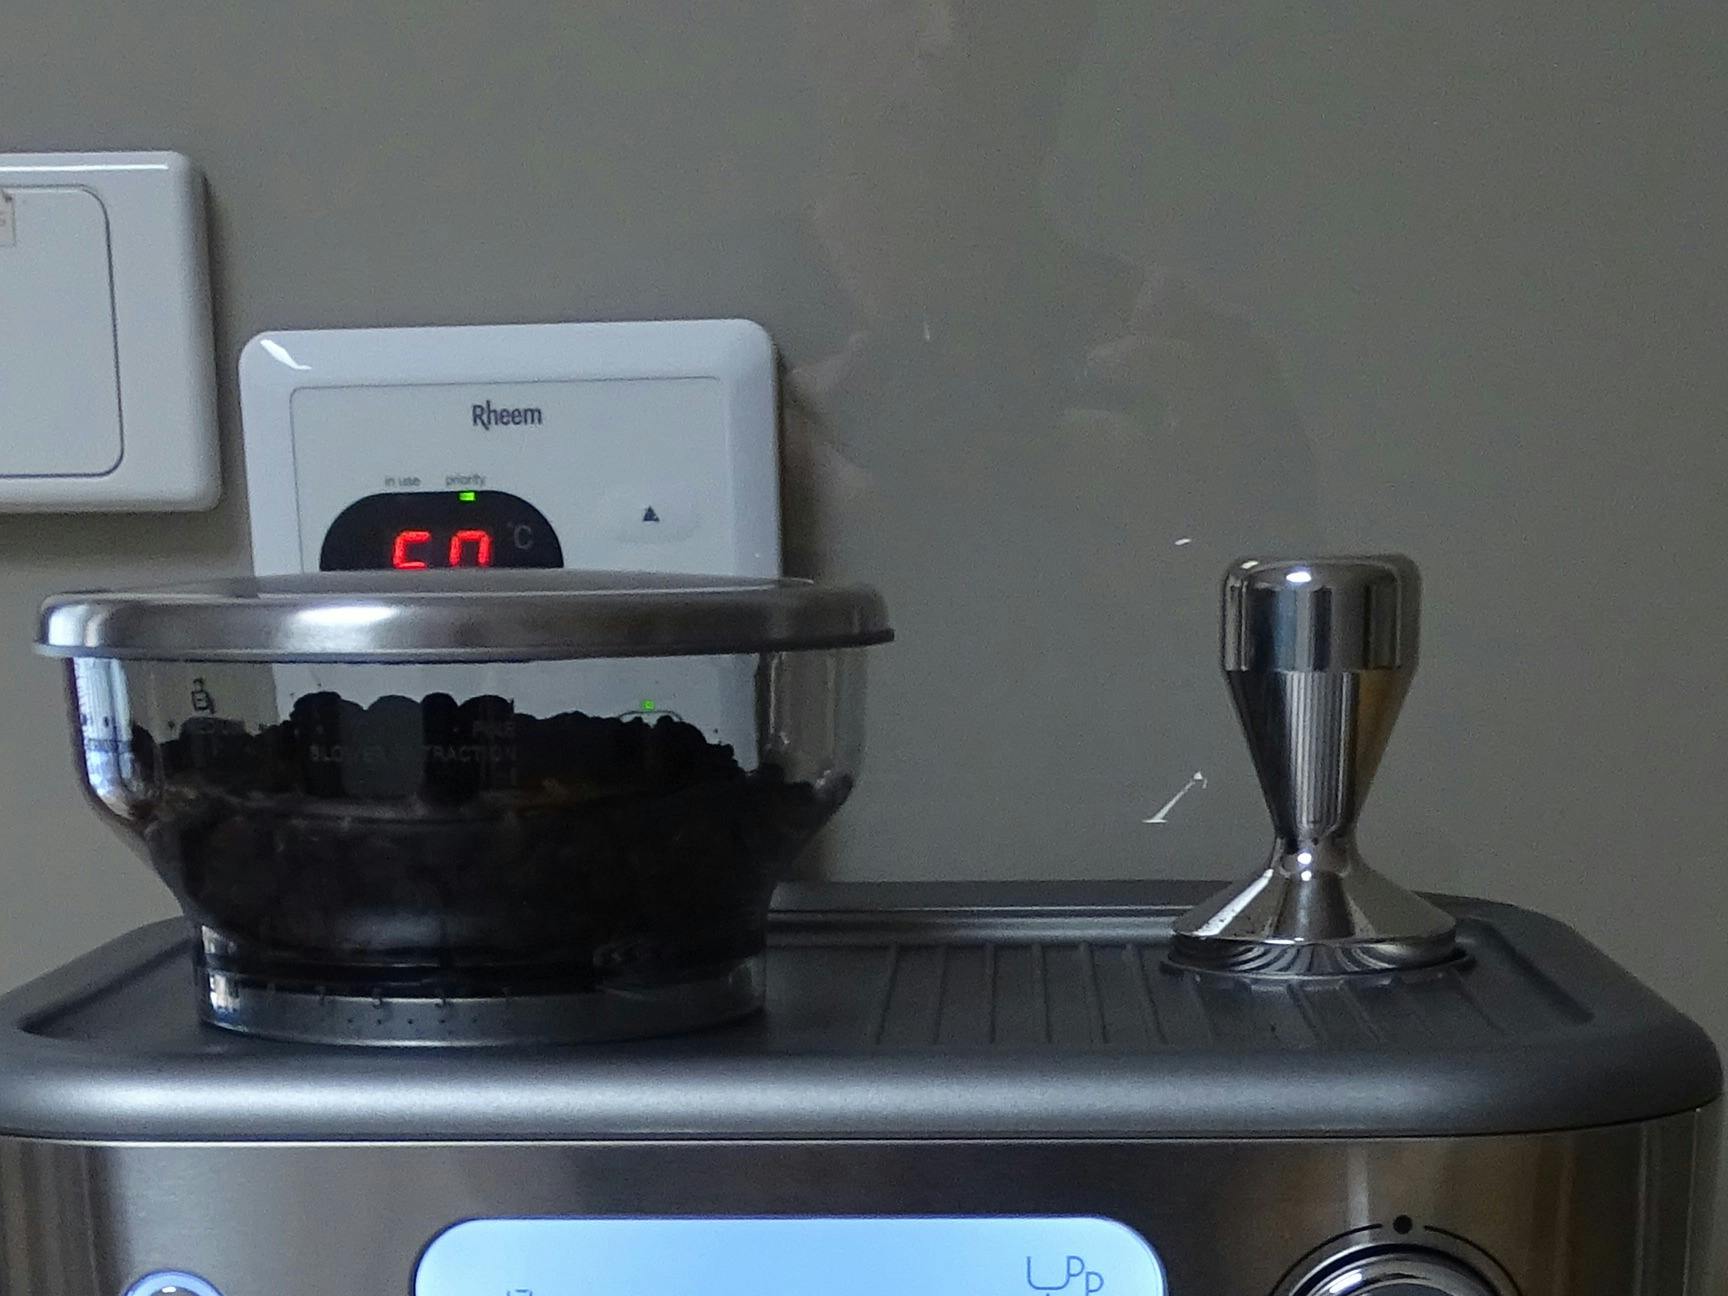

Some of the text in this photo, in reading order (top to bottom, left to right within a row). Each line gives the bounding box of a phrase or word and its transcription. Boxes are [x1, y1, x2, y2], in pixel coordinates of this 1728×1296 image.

[472, 400, 544, 430] Rheem
[384, 475, 421, 487] in use
[445, 473, 487, 488] priority
